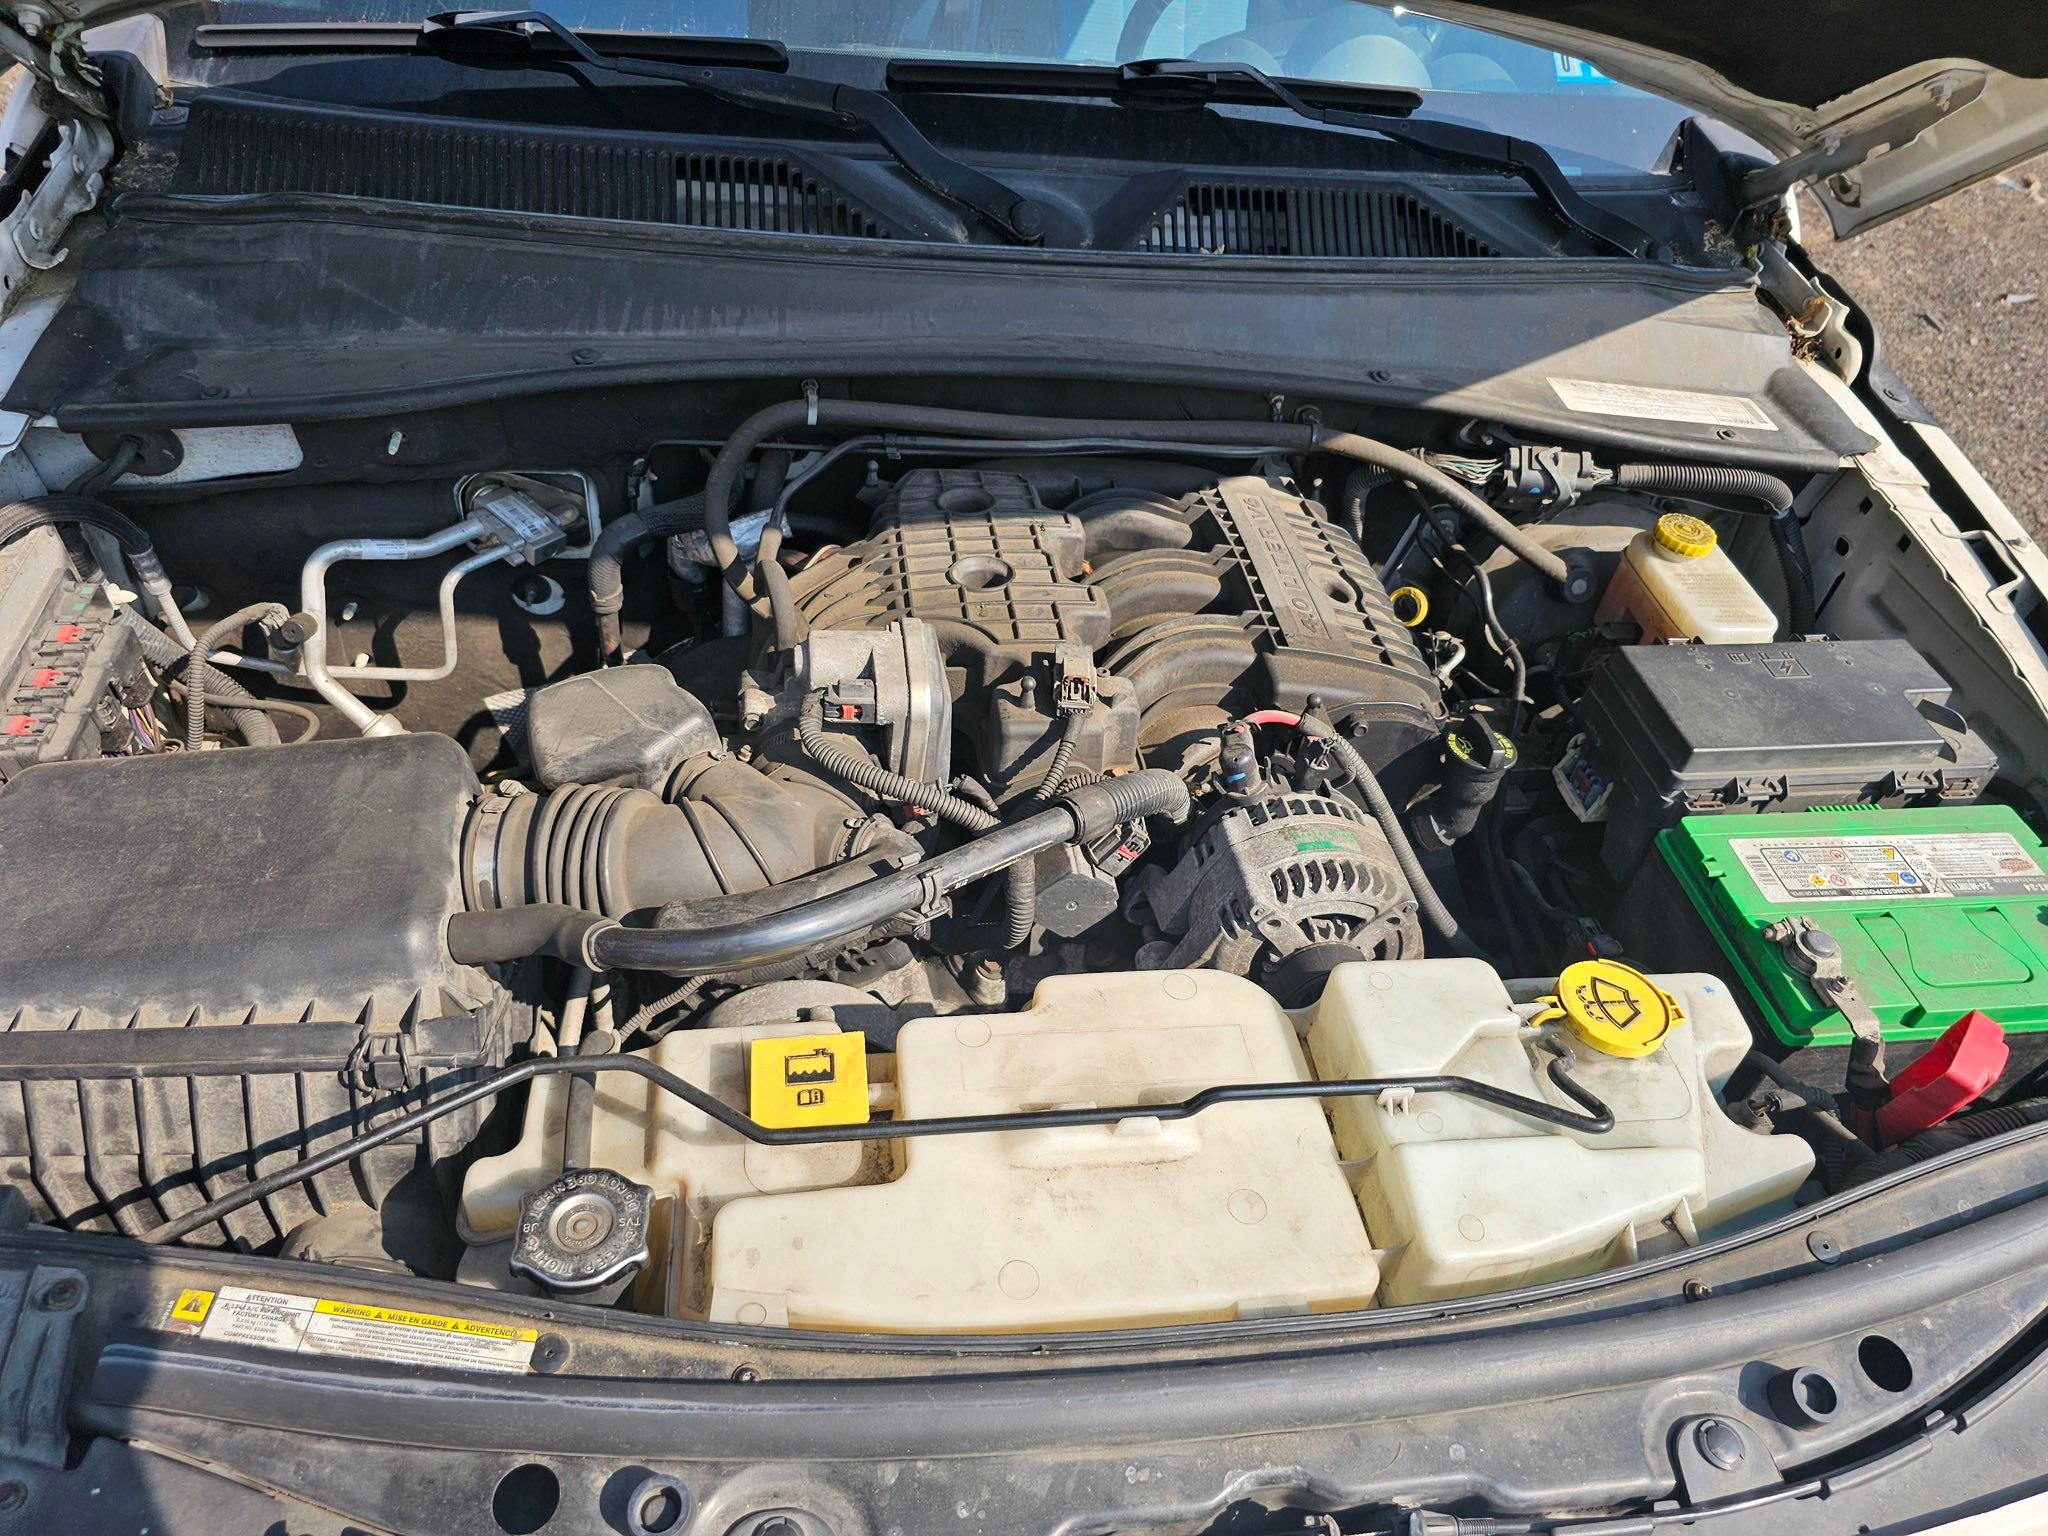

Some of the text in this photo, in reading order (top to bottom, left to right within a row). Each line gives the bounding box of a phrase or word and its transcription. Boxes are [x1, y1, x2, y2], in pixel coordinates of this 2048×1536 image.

[1243, 497, 1320, 634] 4.0 LITER V6
[552, 1173, 597, 1192] OPEN
[599, 1177, 628, 1194] NOT
[529, 1191, 556, 1220] HOT
[624, 1192, 640, 1211] DO
[619, 1217, 641, 1227] TVS
[528, 1249, 573, 1277] TIGHT
[246, 1294, 289, 1305] ATTENTION
[232, 1310, 260, 1318] FACTORY
[333, 1305, 371, 1317] WARNING
[388, 1313, 449, 1328] MISE EN GARDE
